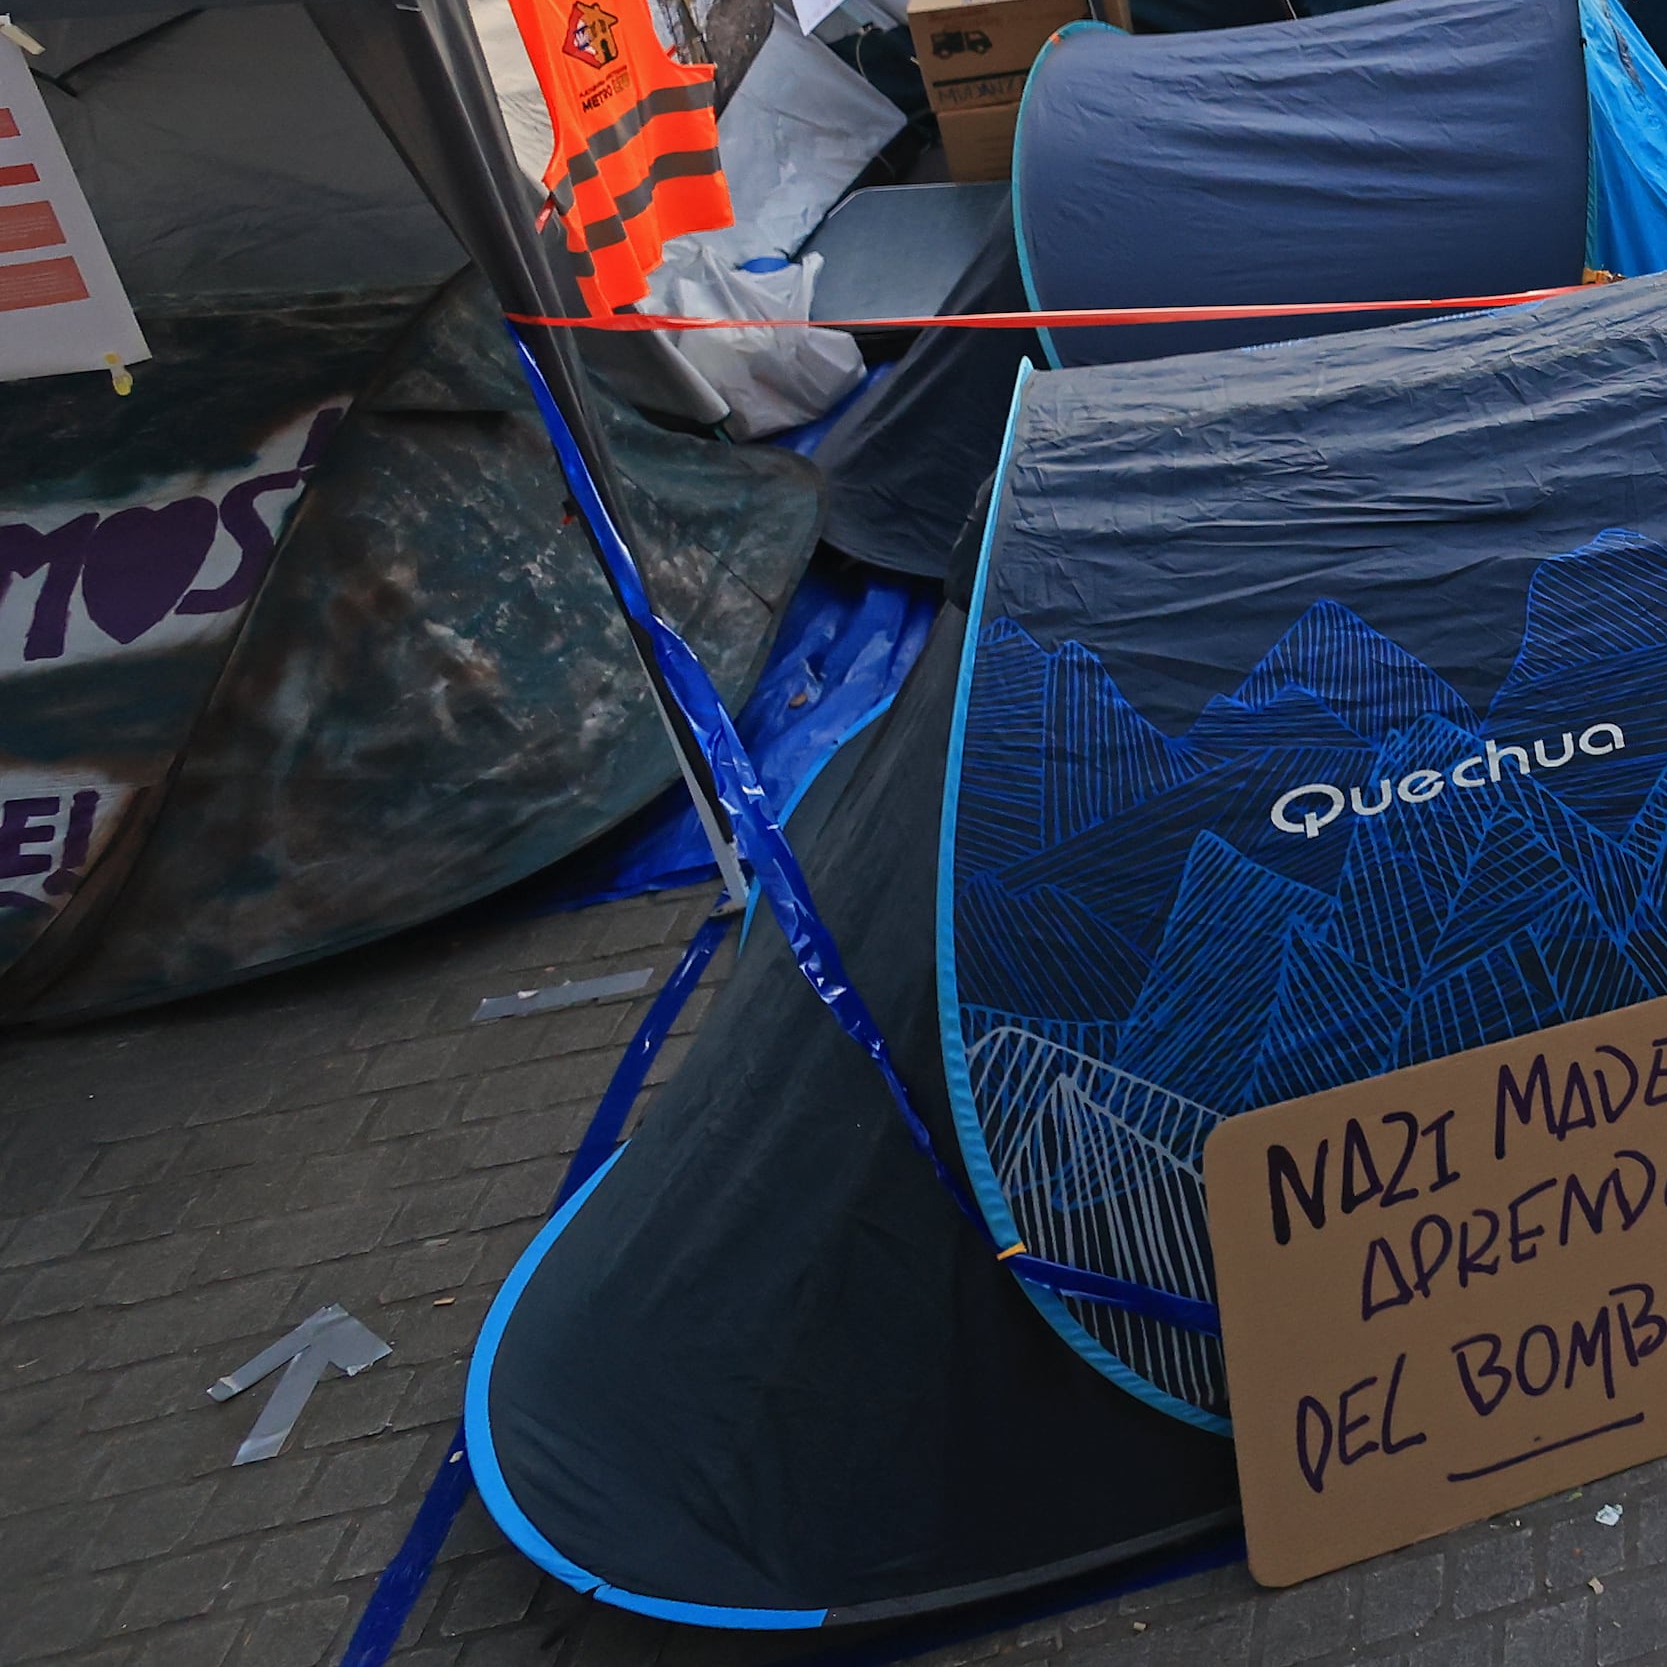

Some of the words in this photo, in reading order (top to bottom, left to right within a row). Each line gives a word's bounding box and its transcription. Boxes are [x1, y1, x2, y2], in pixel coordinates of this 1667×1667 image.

[1270, 722, 1625, 838] Quechua
[1266, 1110, 1461, 1245] NAZI
[1296, 1353, 1427, 1494] DEL
